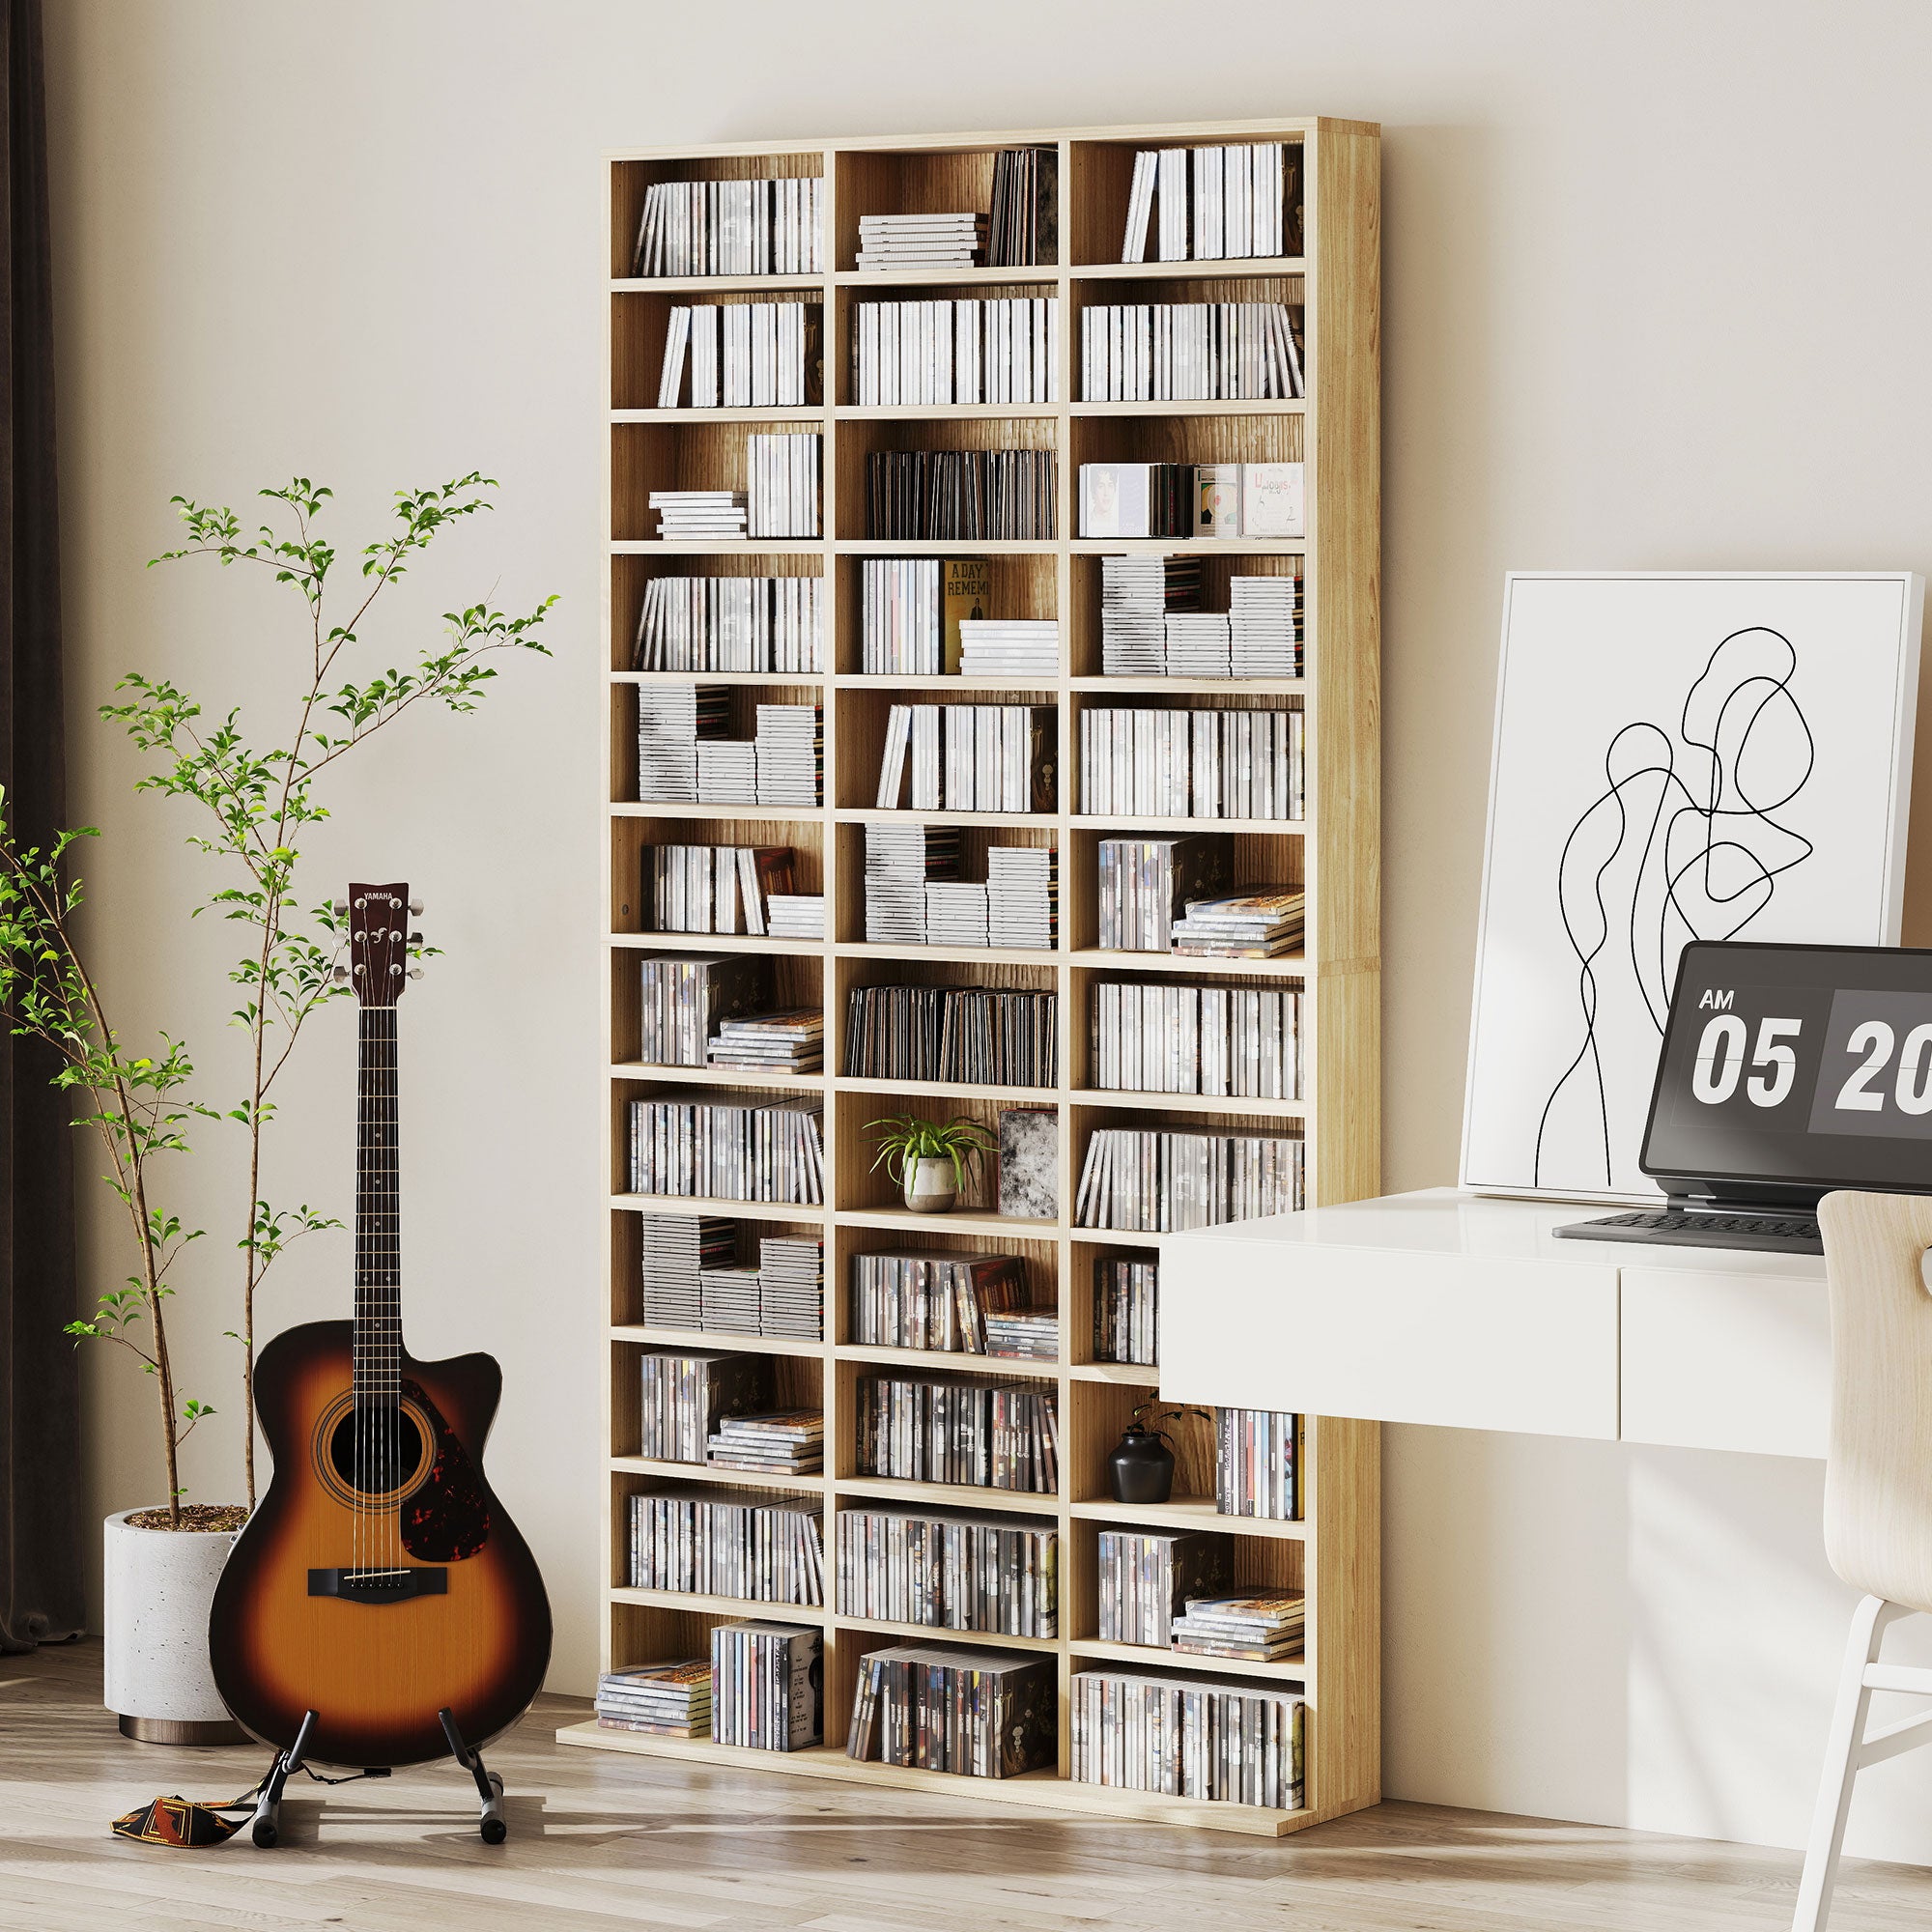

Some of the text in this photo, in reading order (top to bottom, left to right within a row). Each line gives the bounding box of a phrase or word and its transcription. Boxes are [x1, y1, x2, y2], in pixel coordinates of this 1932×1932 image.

[952, 563, 983, 579] A DAY
[1698, 989, 1735, 1010] AM
[1691, 1014, 1932, 1116] 05 20
